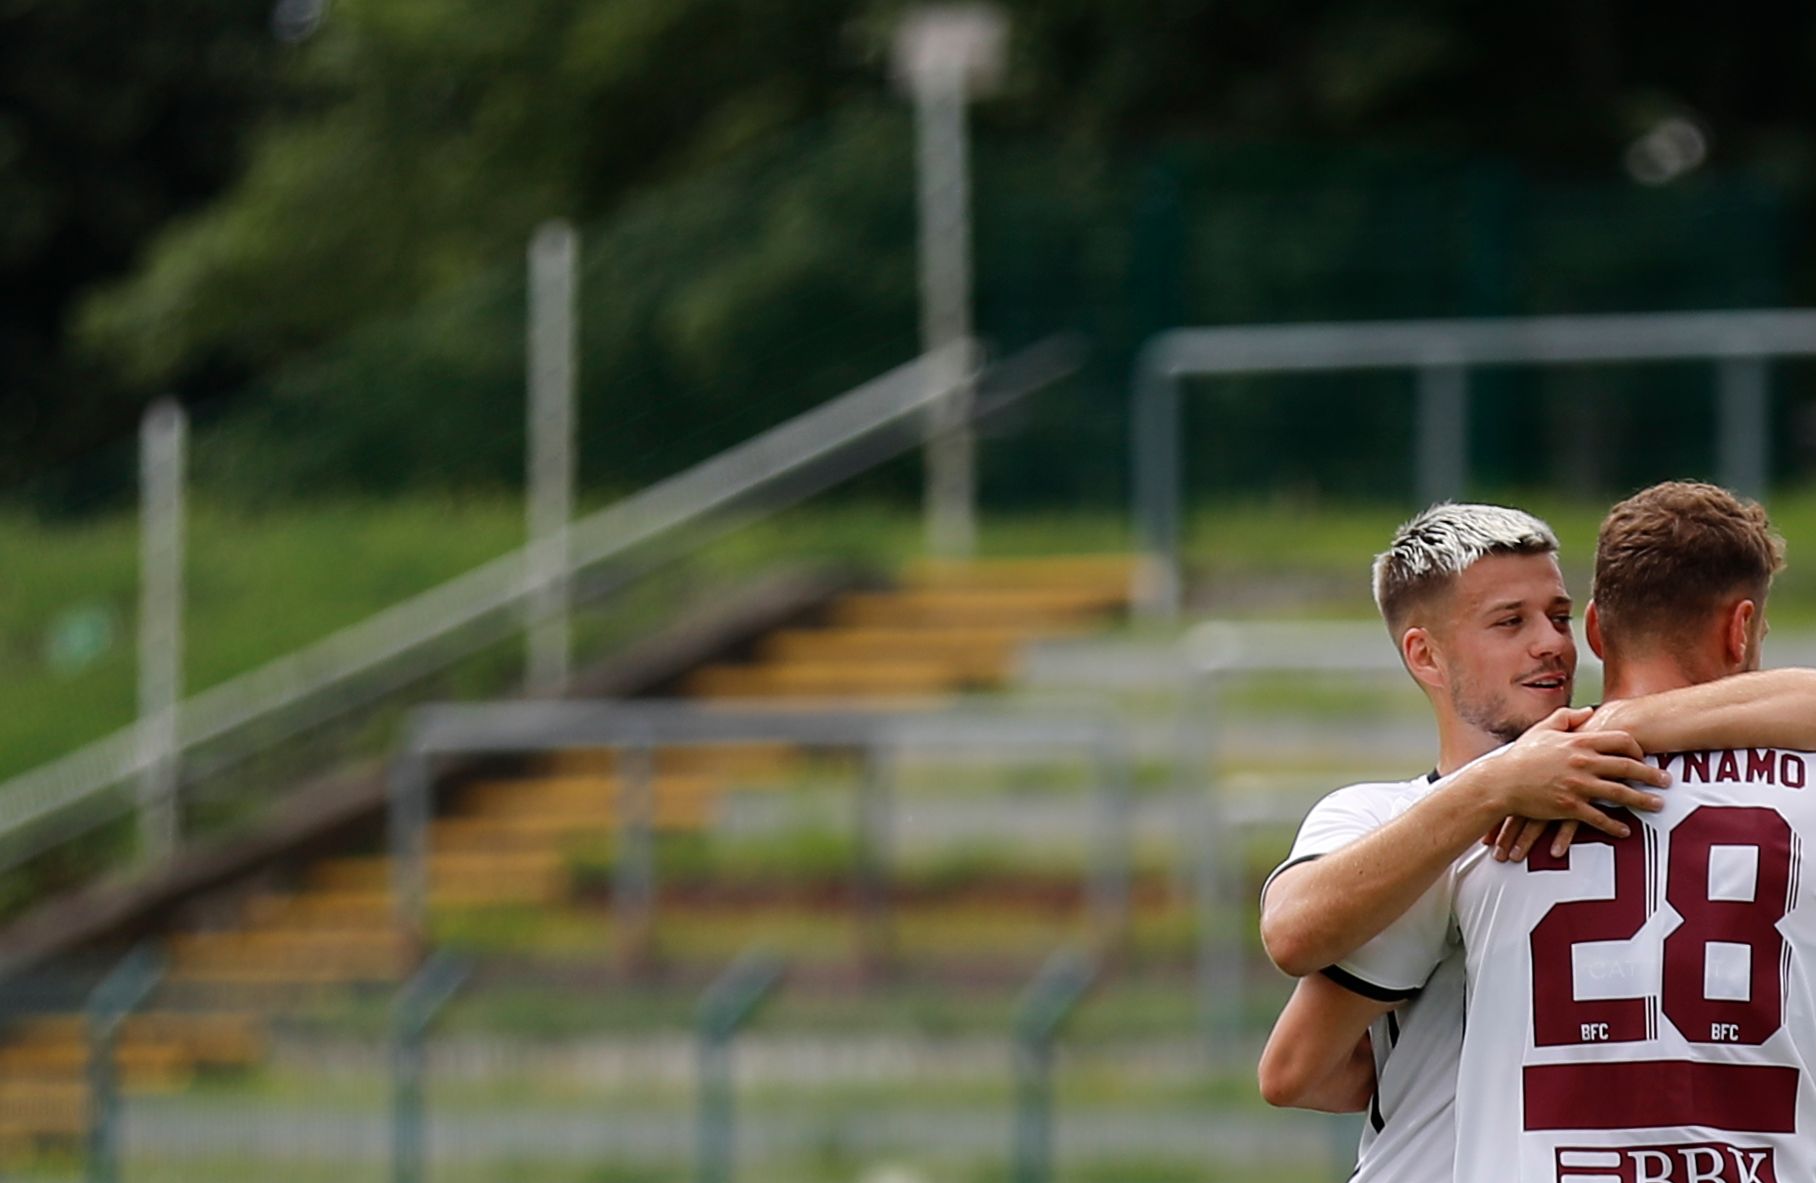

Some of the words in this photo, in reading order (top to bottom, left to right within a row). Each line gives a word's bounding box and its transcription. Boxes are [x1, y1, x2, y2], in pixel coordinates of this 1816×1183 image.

[1654, 749, 1805, 789] YNAMO
[1527, 804, 1798, 1047] 28
[1581, 1023, 1609, 1041] BFC
[1711, 1023, 1739, 1042] BFC
